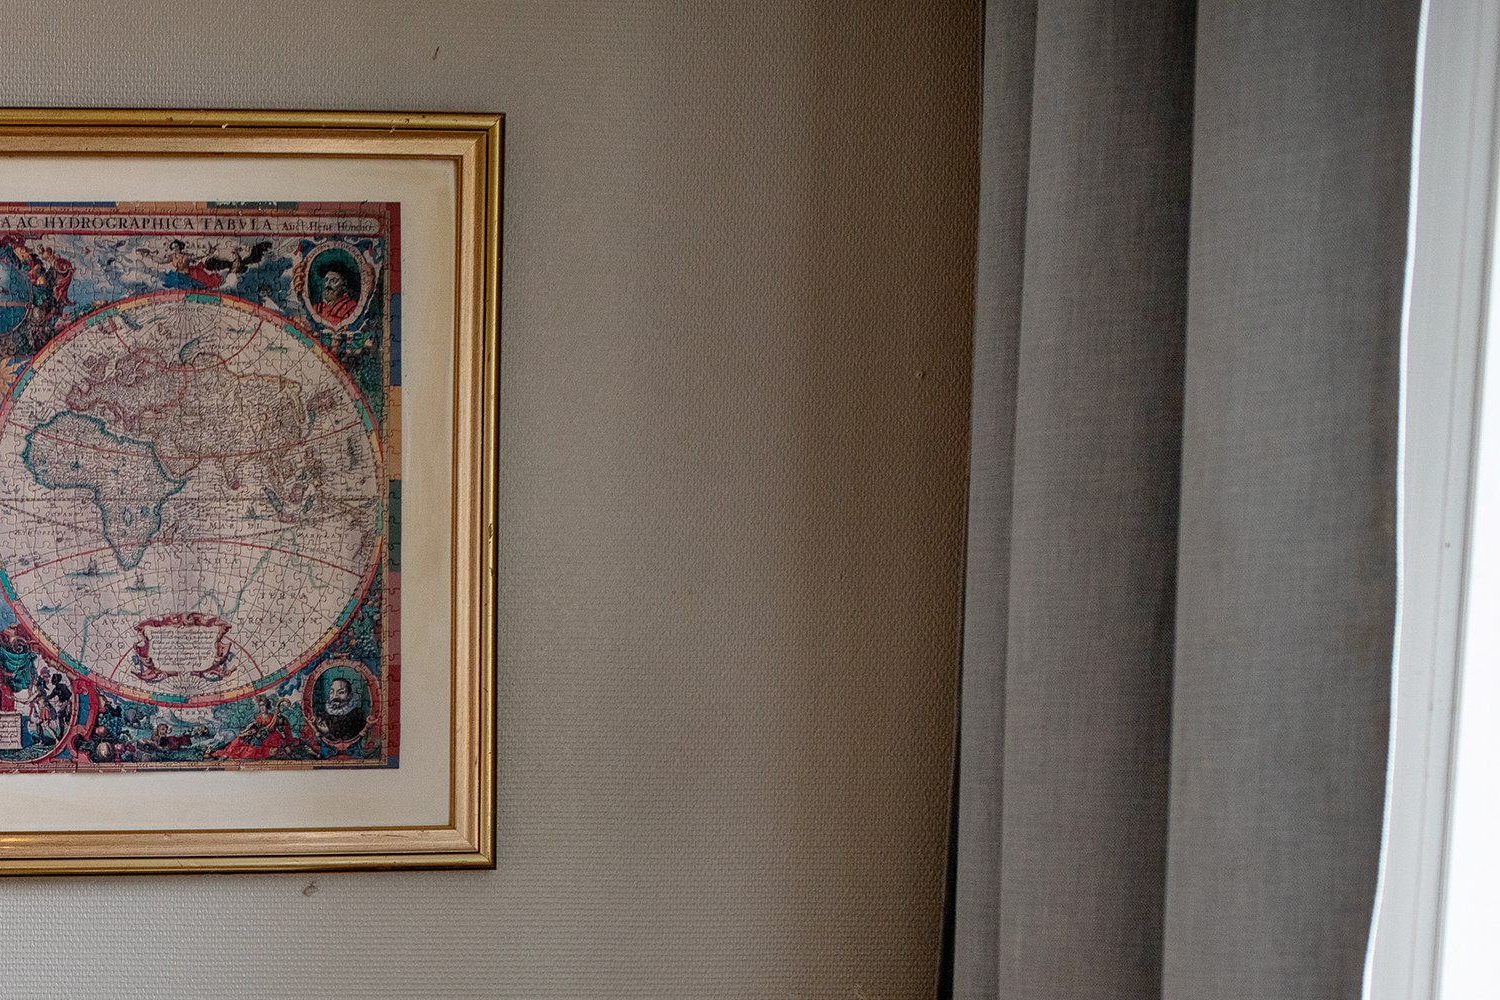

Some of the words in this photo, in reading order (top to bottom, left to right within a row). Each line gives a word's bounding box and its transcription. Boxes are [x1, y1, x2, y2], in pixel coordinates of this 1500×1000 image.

[15, 214, 38, 229] AC
[43, 215, 195, 230] HYDROGRAPHICA
[202, 216, 273, 231] TABVLA
